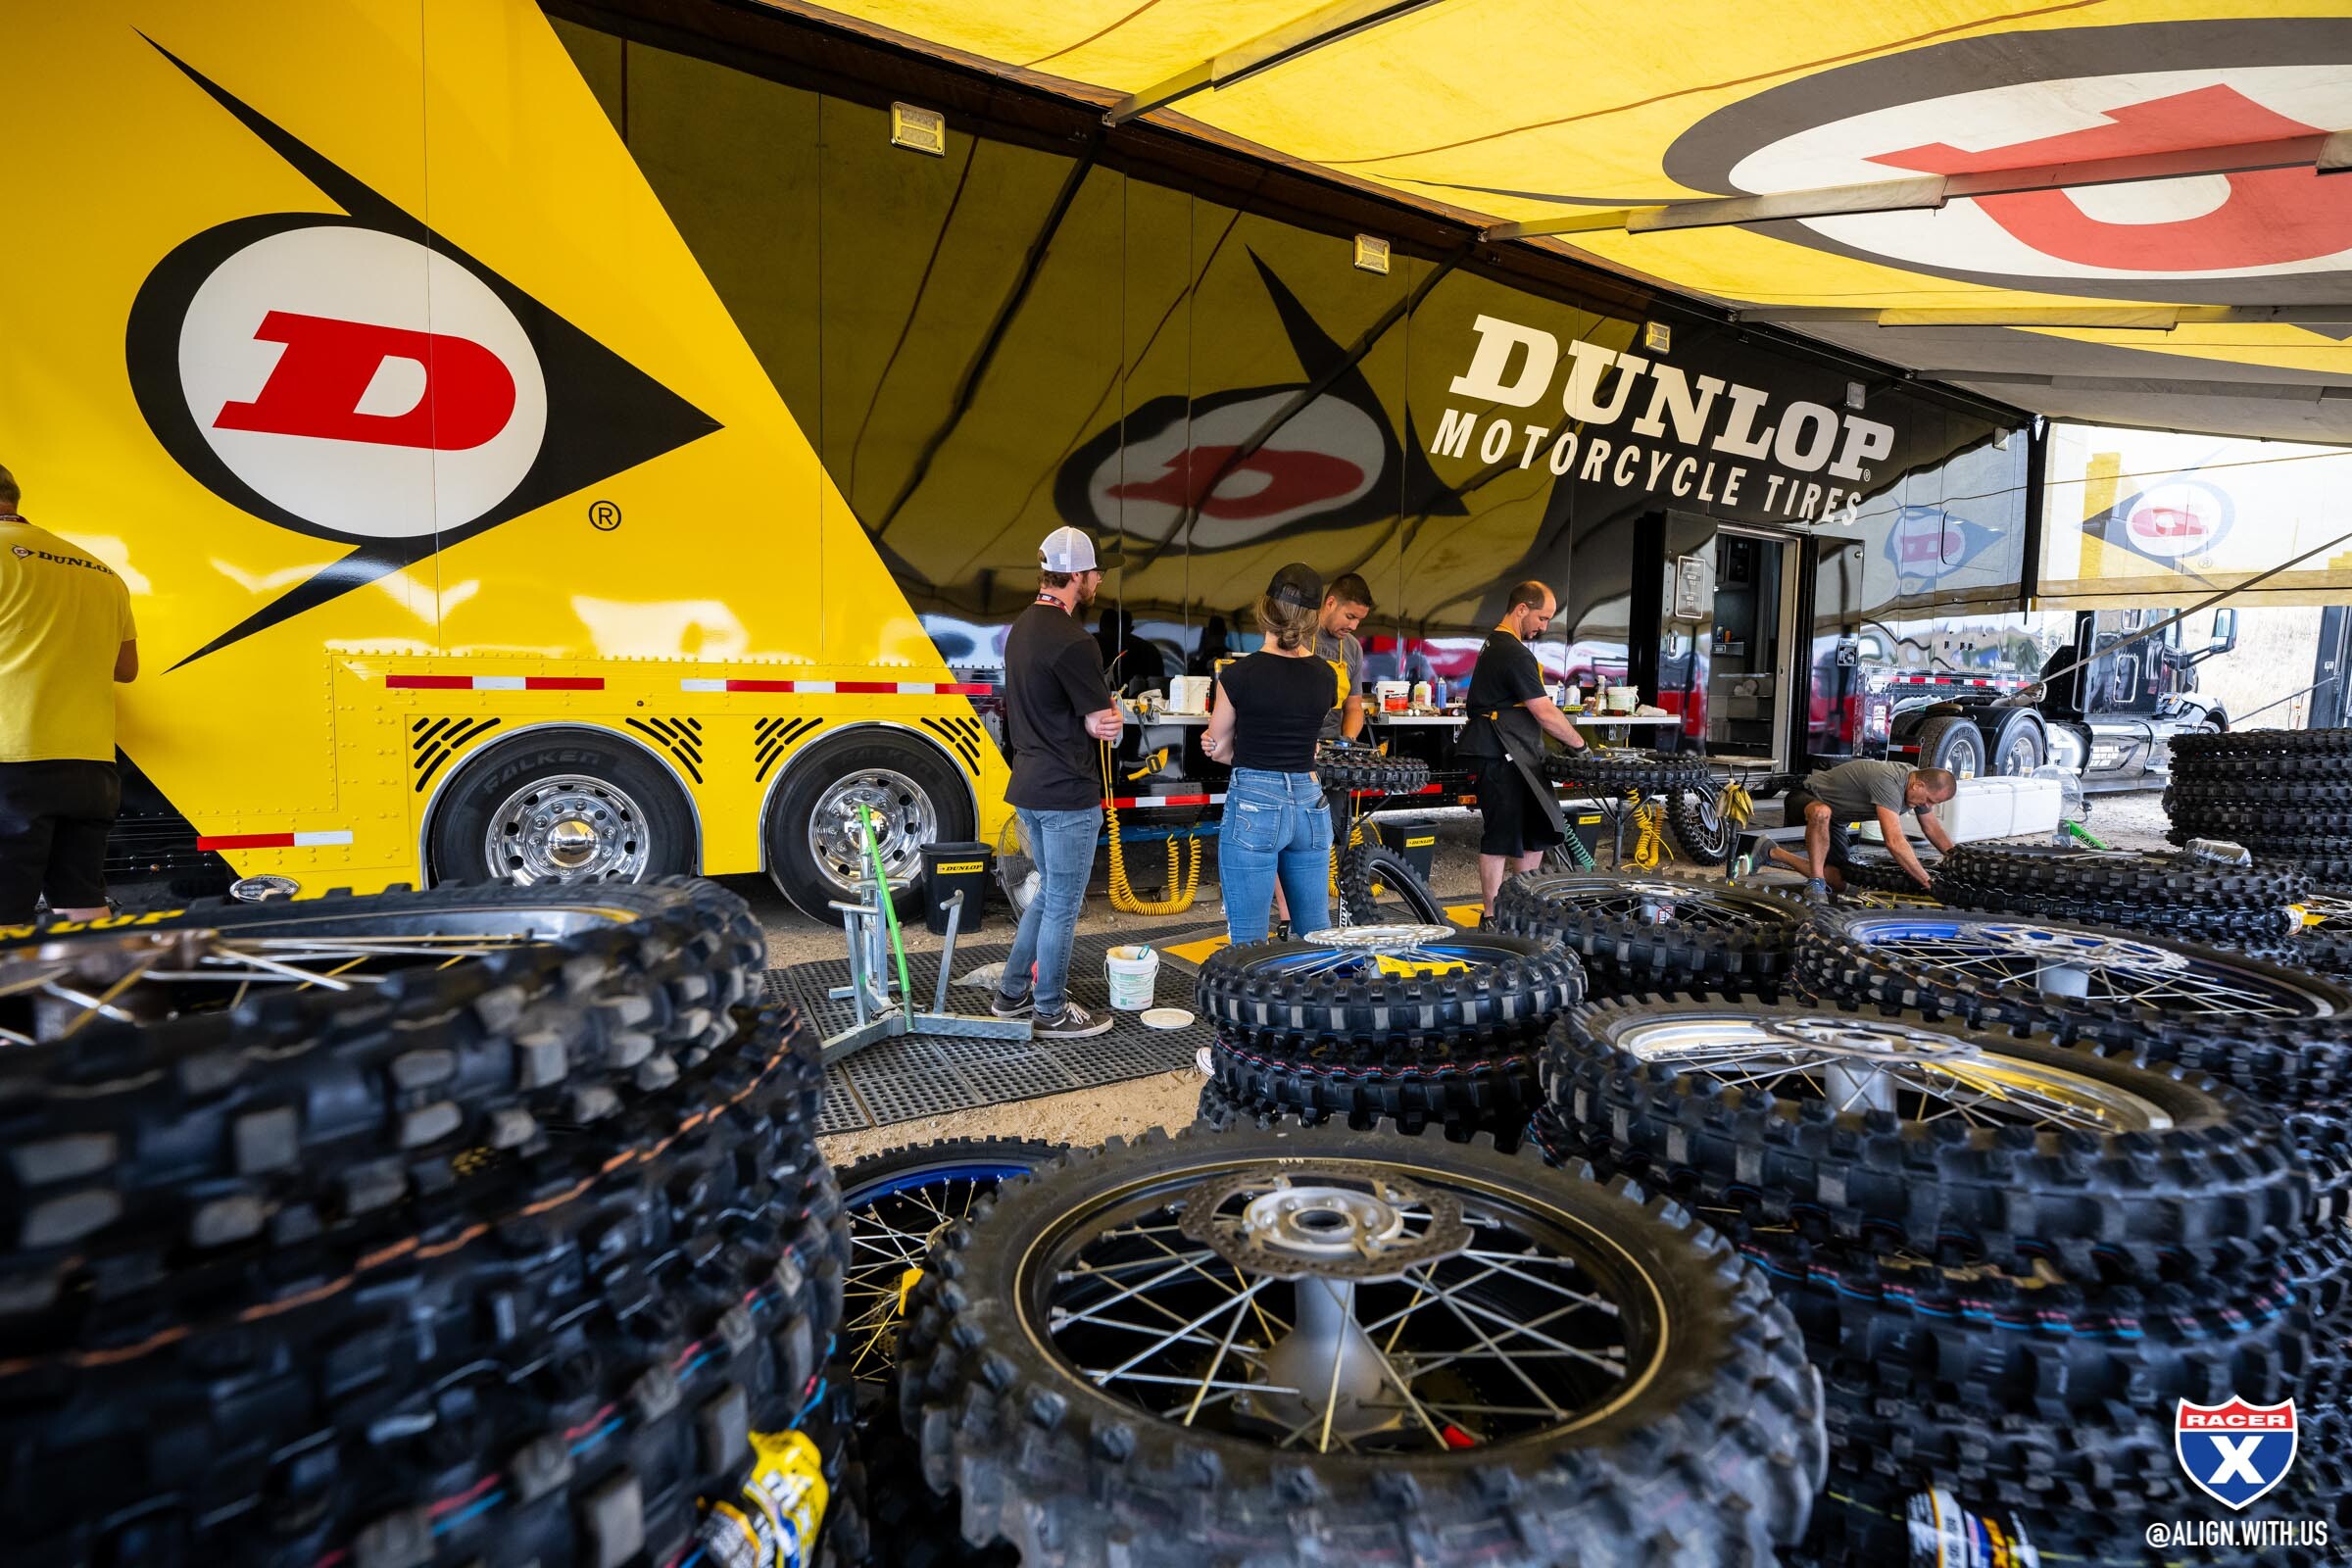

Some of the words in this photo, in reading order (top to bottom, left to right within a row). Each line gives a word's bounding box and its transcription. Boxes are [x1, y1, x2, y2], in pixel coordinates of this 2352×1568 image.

[213, 311, 515, 451] D
[1448, 314, 1895, 481] DUNLOP
[1430, 409, 1747, 507] MOTORCYCLE
[1763, 475, 1863, 526] TIRES
[483, 750, 601, 795] FALKEN
